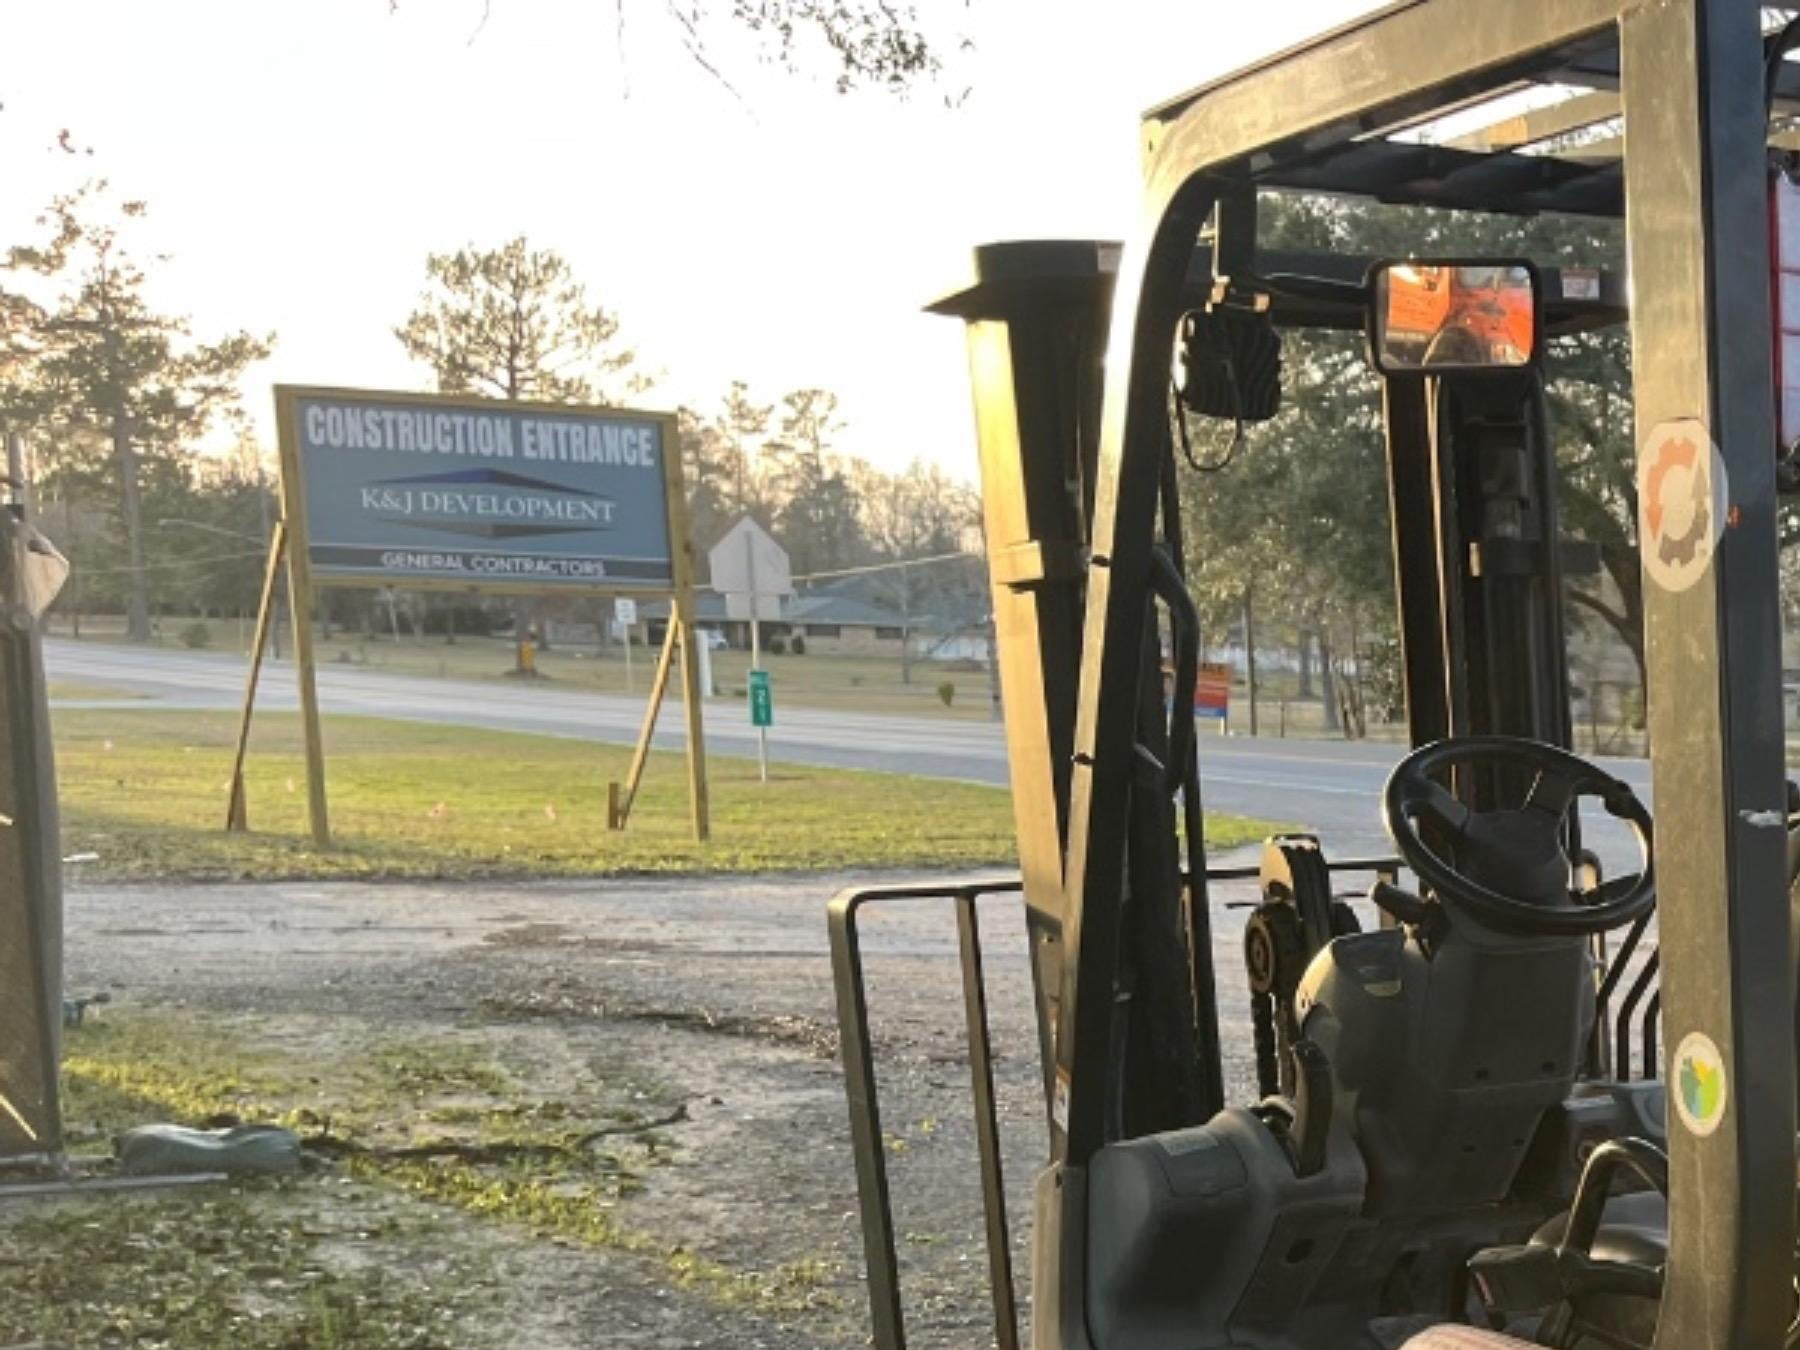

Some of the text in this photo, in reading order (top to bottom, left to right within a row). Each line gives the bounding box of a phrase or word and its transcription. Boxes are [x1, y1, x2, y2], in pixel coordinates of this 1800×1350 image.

[305, 405, 655, 467] CONSTRUCTION ENTRANCE
[361, 488, 616, 521] K&J DEVELOPMENT
[381, 551, 606, 577] GENERAL CONTRACTORS
